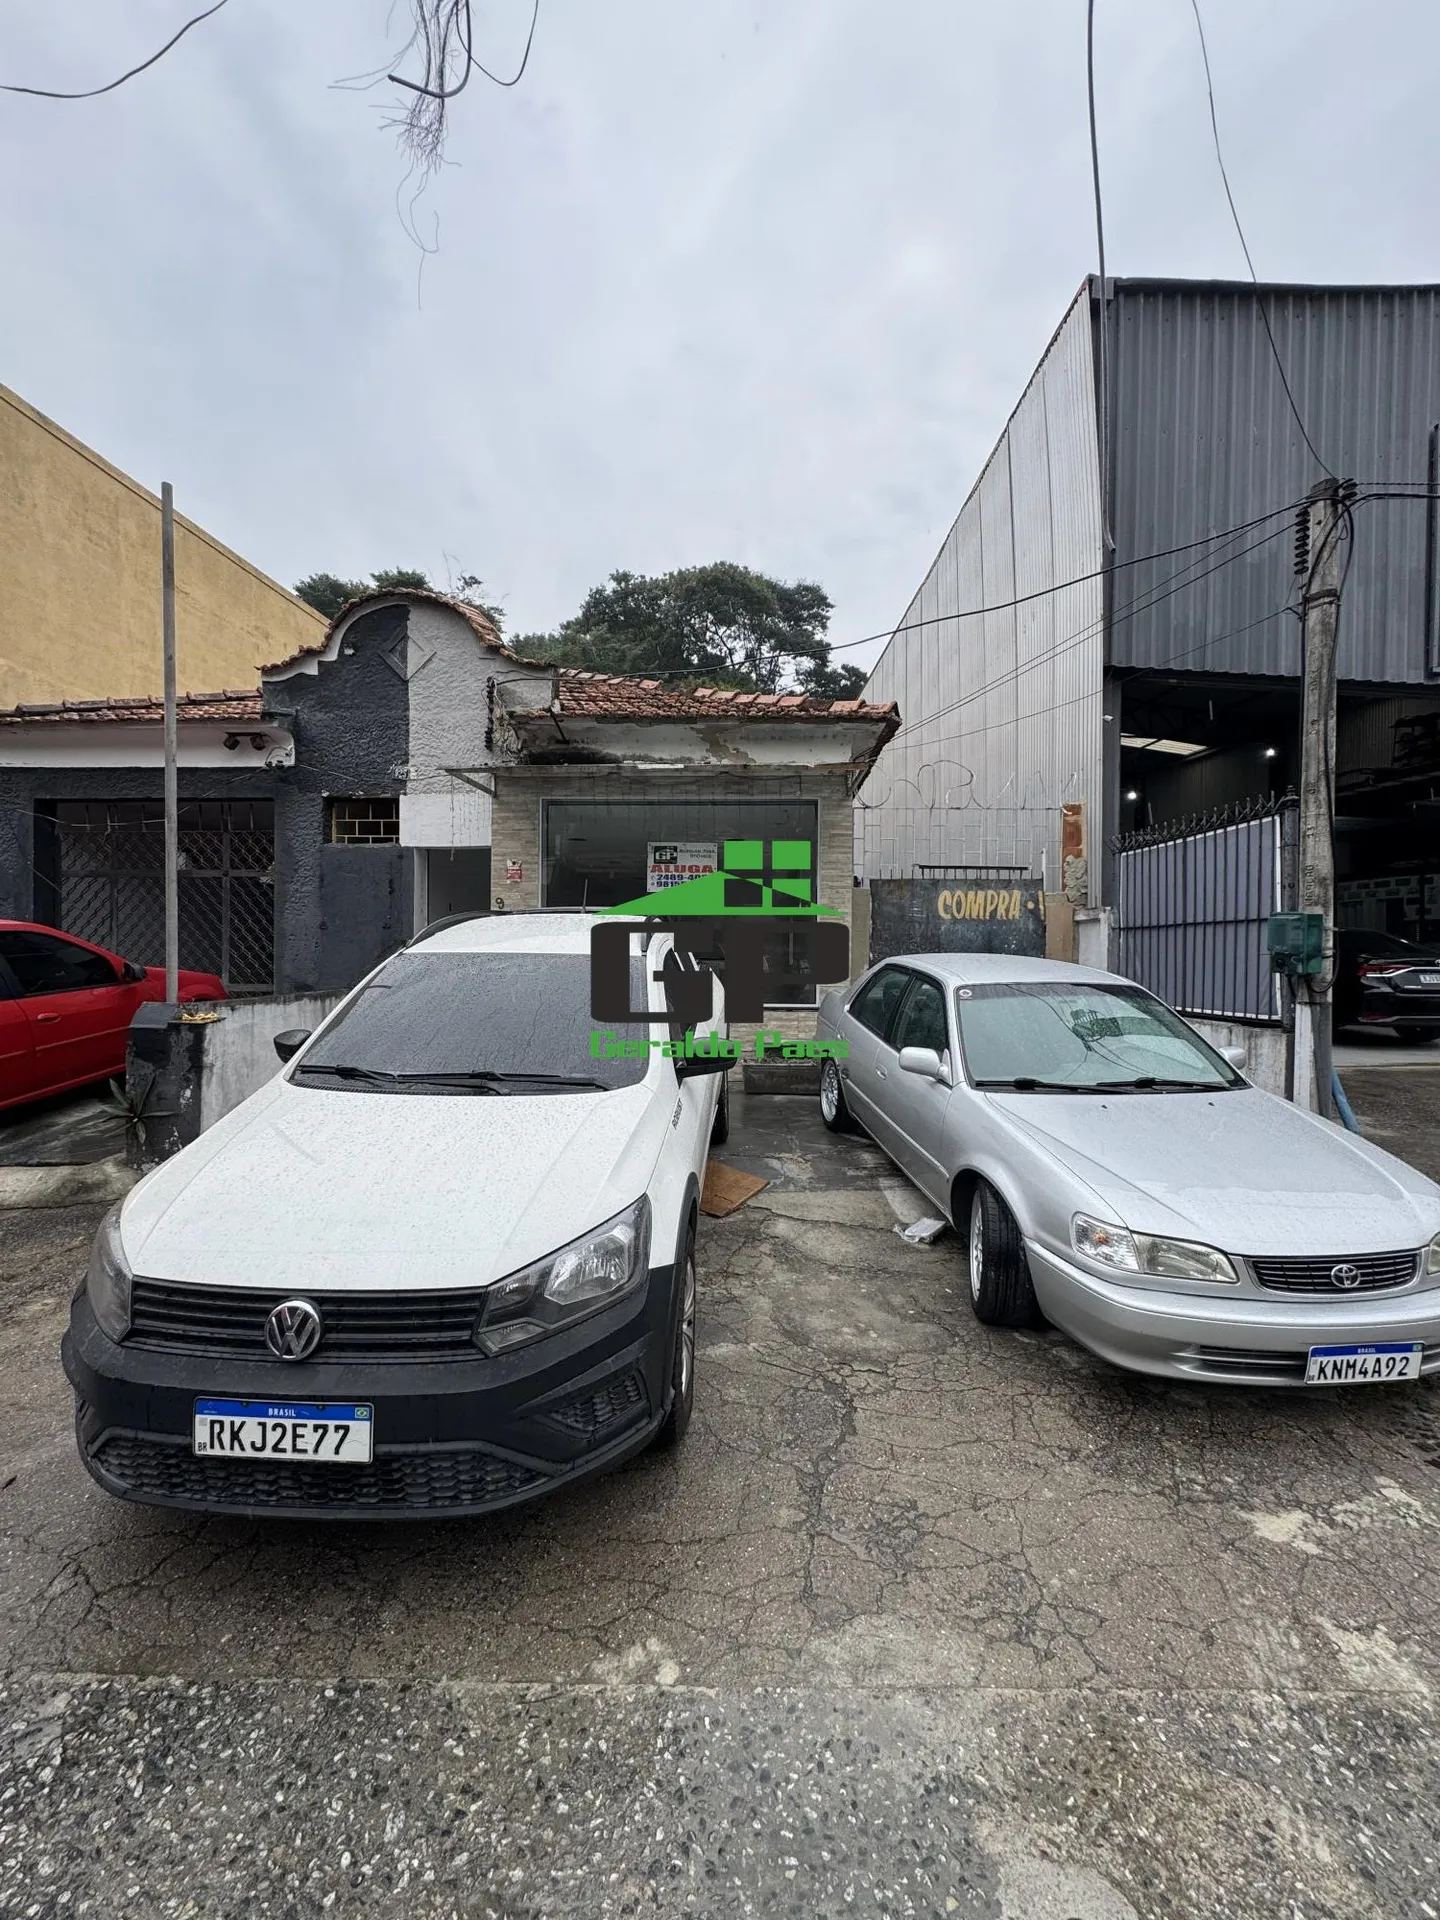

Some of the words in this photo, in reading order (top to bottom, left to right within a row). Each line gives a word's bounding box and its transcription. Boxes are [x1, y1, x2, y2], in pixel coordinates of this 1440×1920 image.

[651, 865, 713, 873] ALUGA
[495, 897, 505, 910] 9
[937, 889, 1021, 920] COMPRA
[1317, 1356, 1410, 1380] KNM4A92
[268, 1408, 297, 1417] BRASIL
[209, 1419, 351, 1455] RKJ2E77
[197, 1441, 208, 1452] BR
